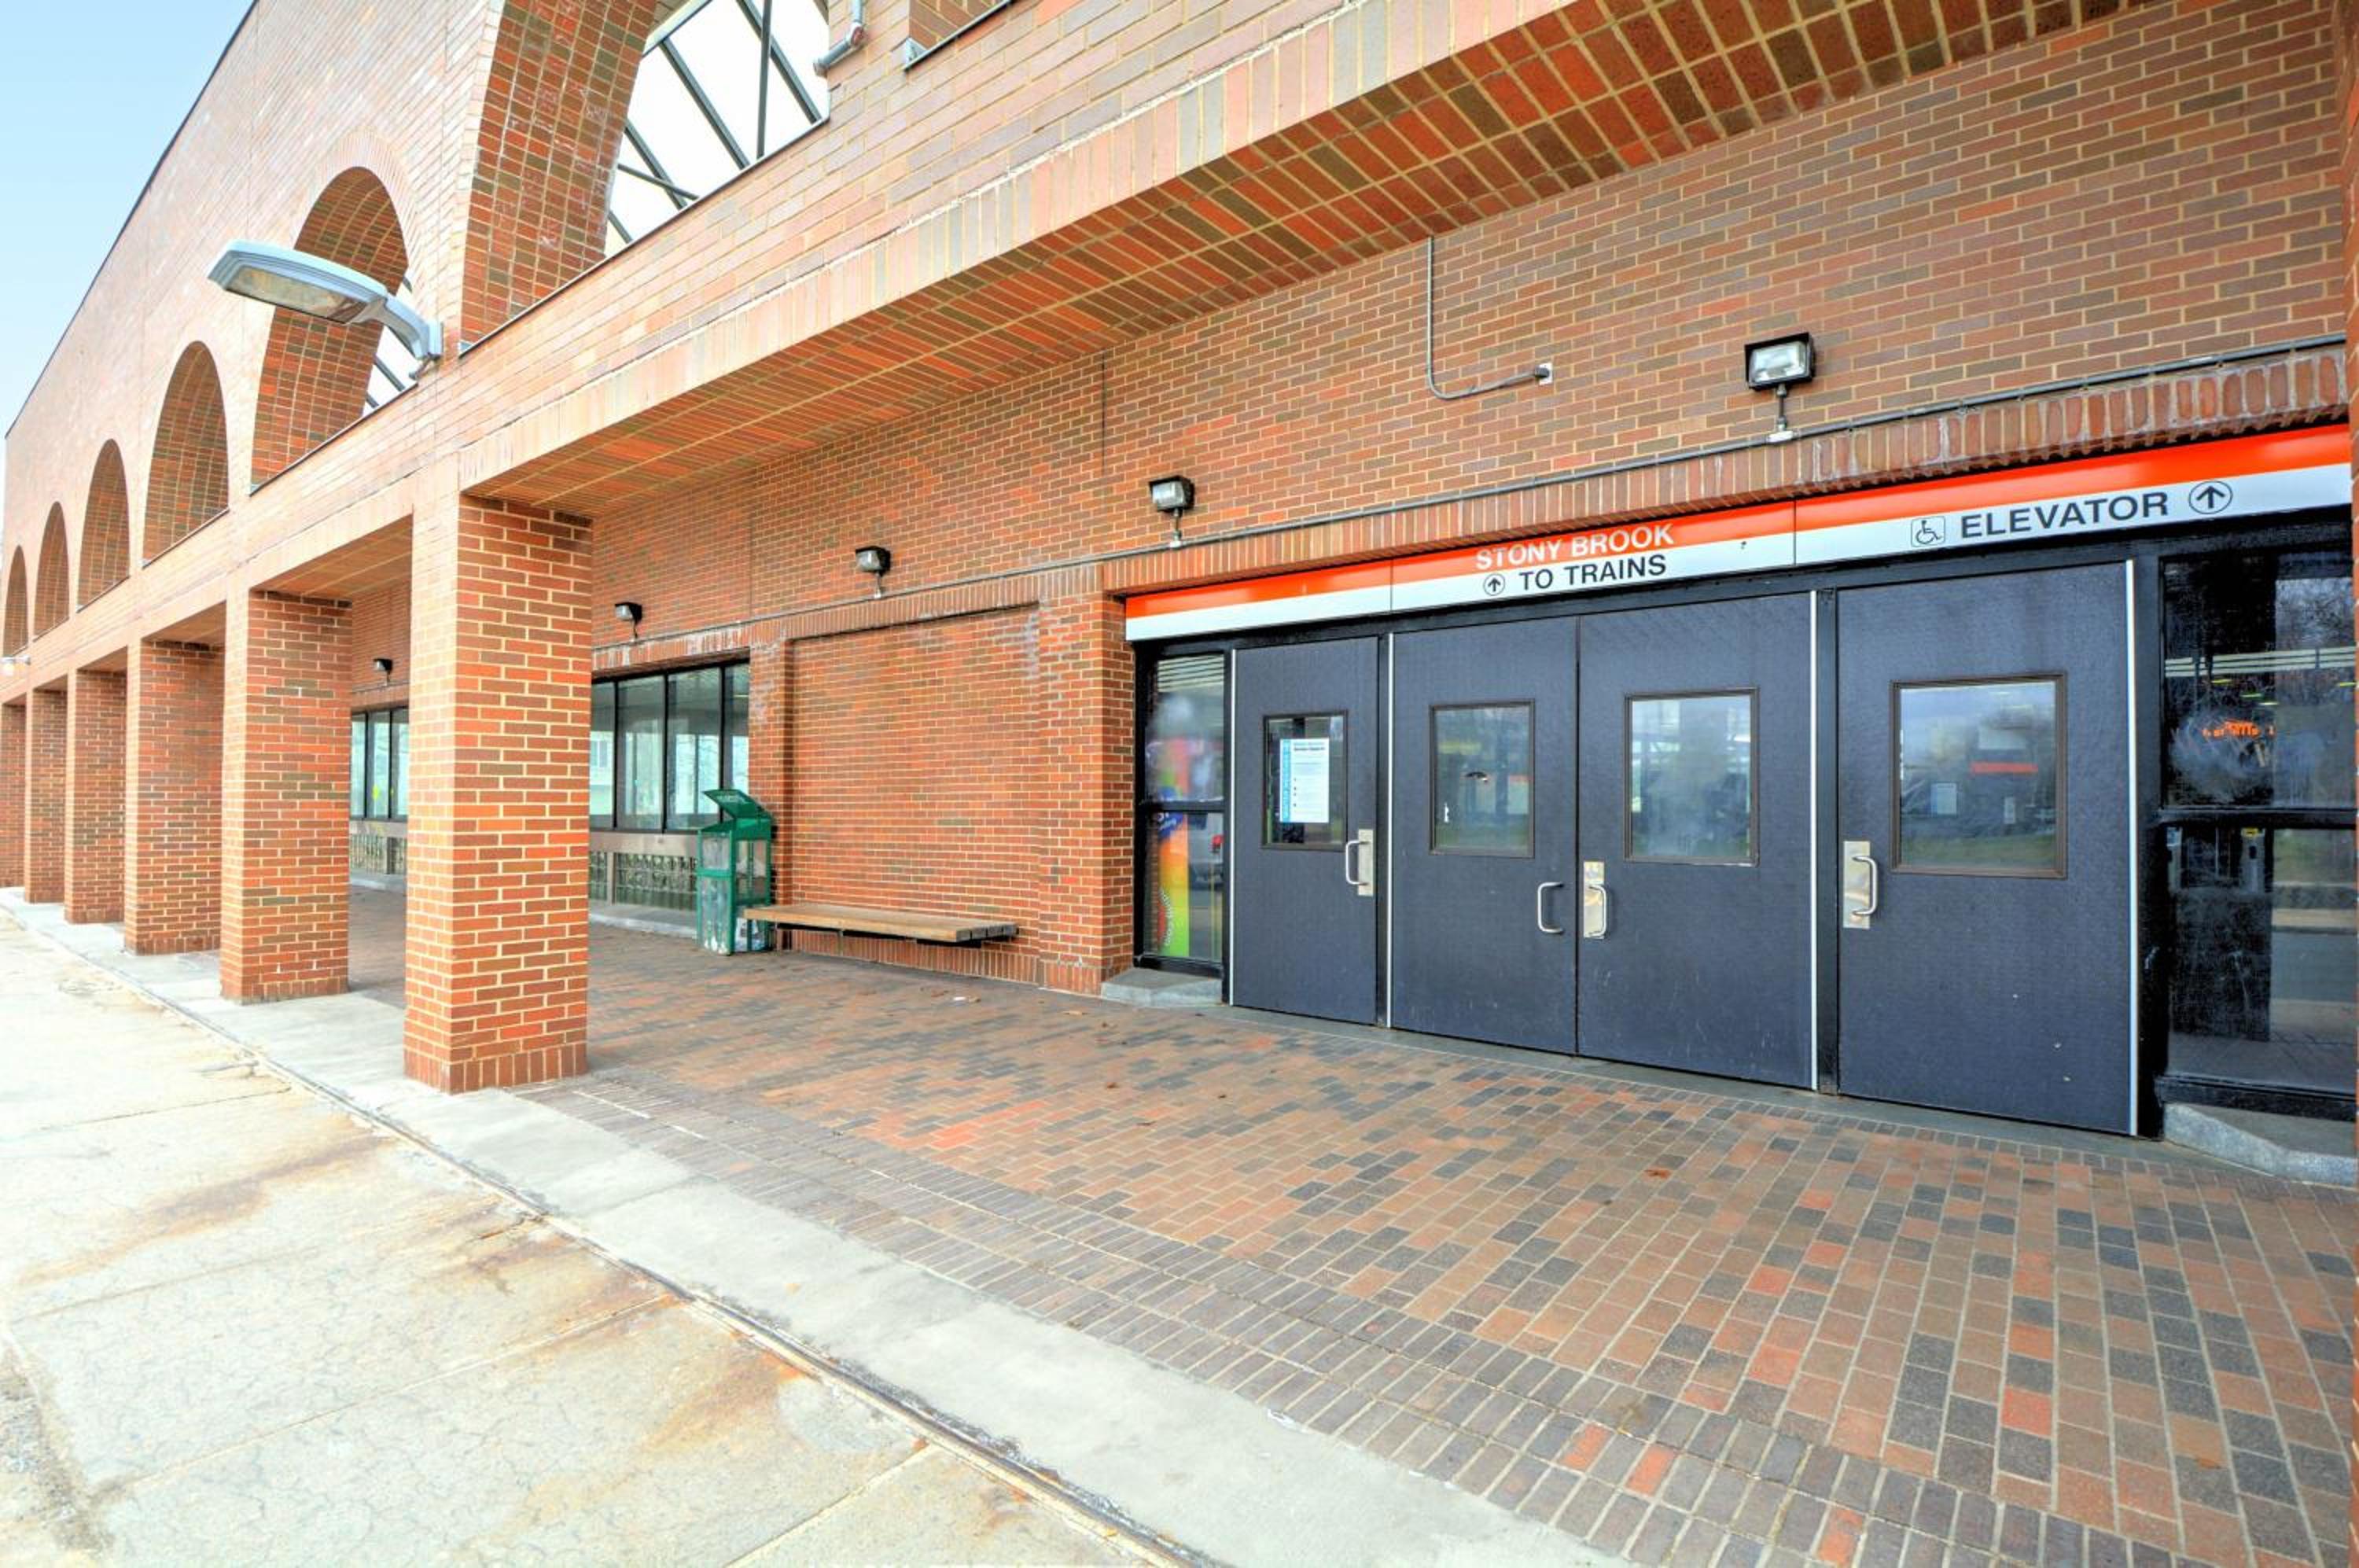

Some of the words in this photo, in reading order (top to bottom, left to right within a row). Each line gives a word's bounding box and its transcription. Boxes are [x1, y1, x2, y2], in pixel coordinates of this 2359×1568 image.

[1961, 491, 2168, 539] ELEVATOR
[1476, 539, 1561, 570] STONY
[1571, 525, 1674, 555] BROOK
[1519, 569, 1554, 591] TO
[1564, 554, 1666, 585] TRAINS
